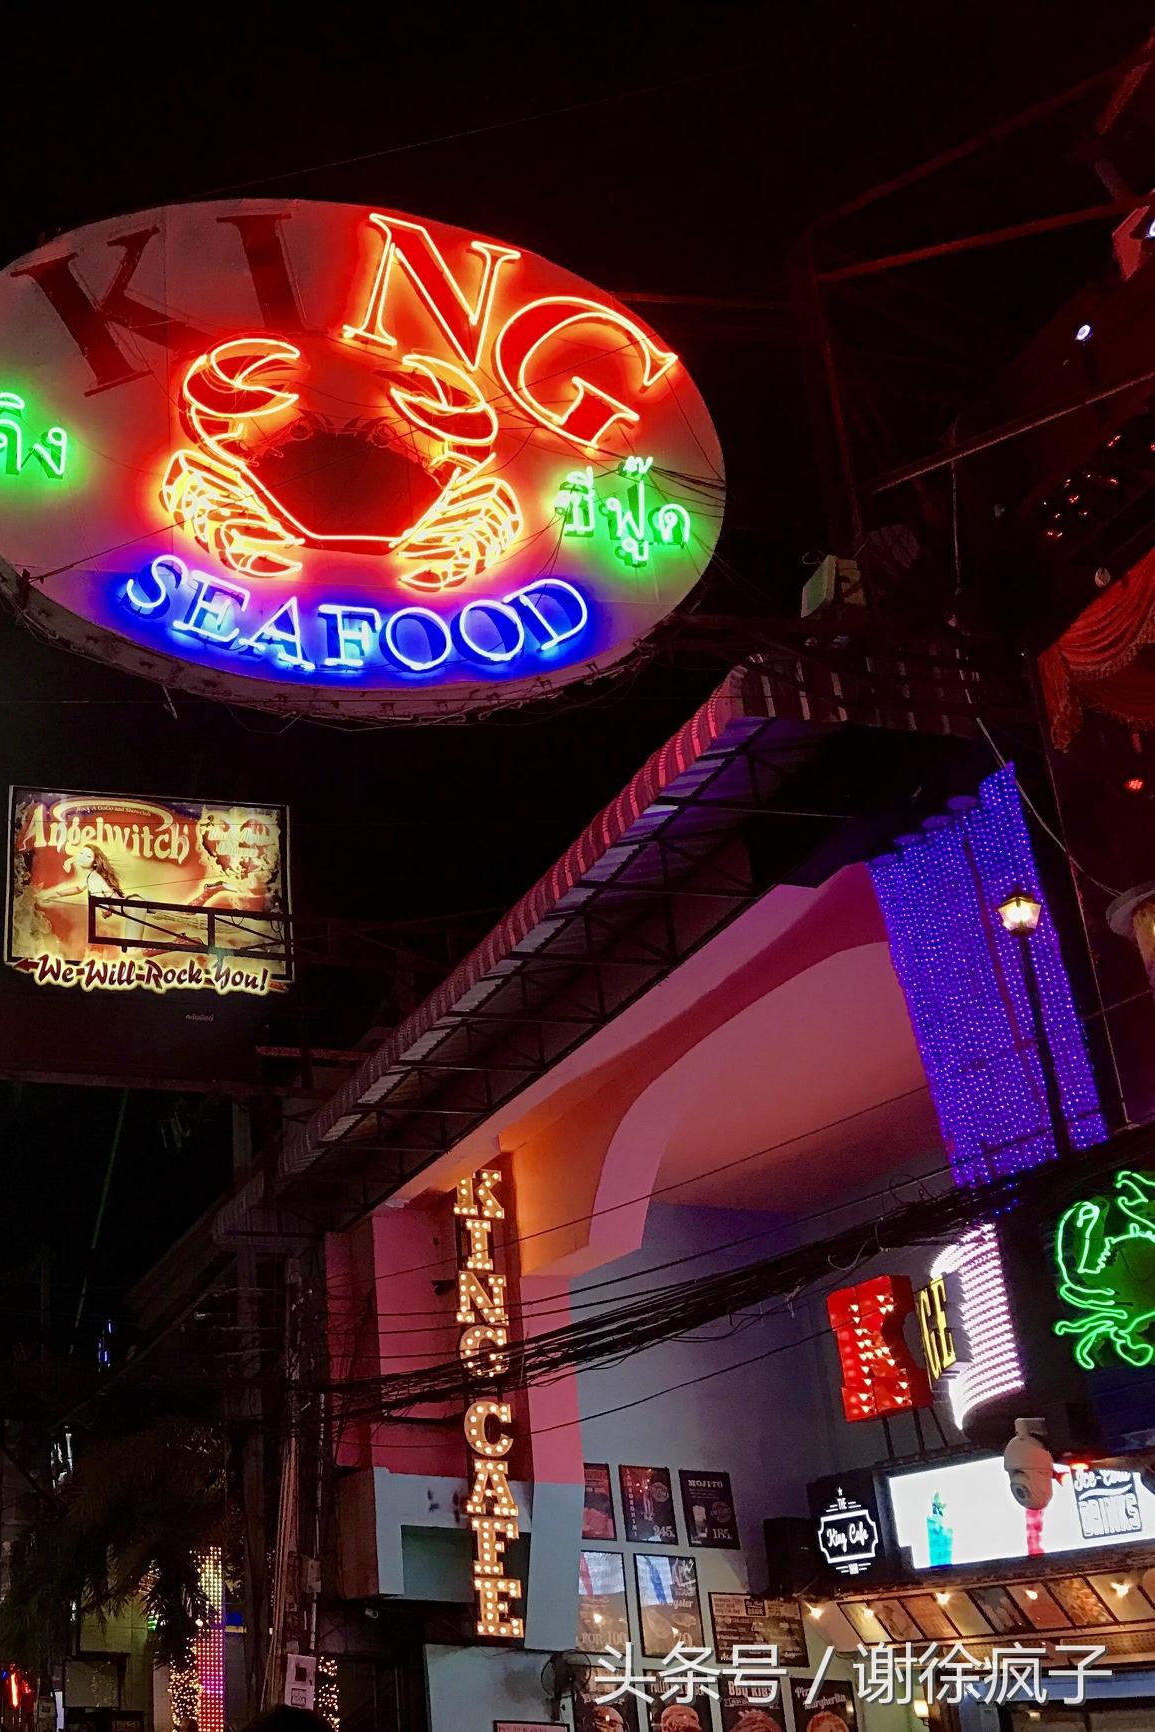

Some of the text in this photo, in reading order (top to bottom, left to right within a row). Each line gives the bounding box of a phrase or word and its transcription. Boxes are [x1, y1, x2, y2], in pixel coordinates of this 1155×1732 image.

[12, 211, 677, 452] KING
[122, 554, 589, 671] SEAFOOD
[18, 803, 190, 872] Angelwitch
[688, 1479, 724, 1489] MOJITO
[1078, 1493, 1142, 1538] DRINKS
[464, 1401, 524, 1638] CAFE
[826, 1527, 848, 1553] King
